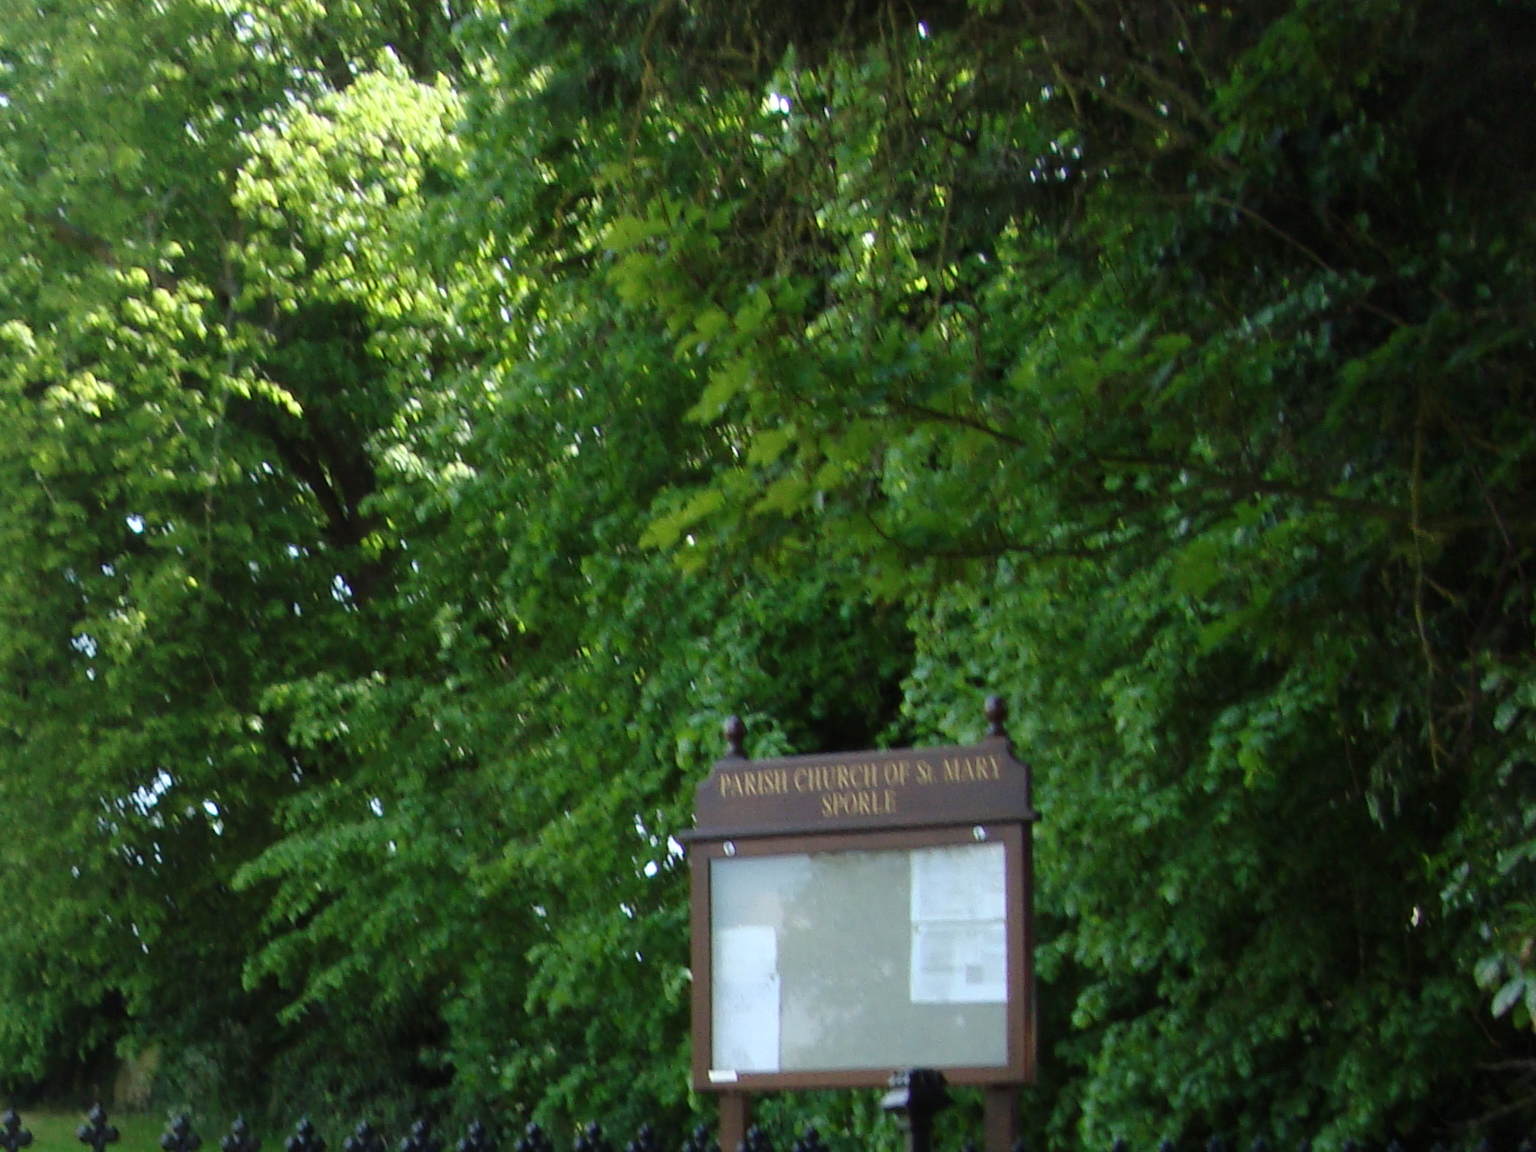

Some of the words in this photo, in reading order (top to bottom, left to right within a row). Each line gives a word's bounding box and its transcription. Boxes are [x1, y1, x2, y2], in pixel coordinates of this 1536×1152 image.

[719, 769, 787, 798] PARISH
[794, 762, 877, 792] CHURCH
[884, 760, 910, 786] OF
[943, 755, 1001, 783] MARY
